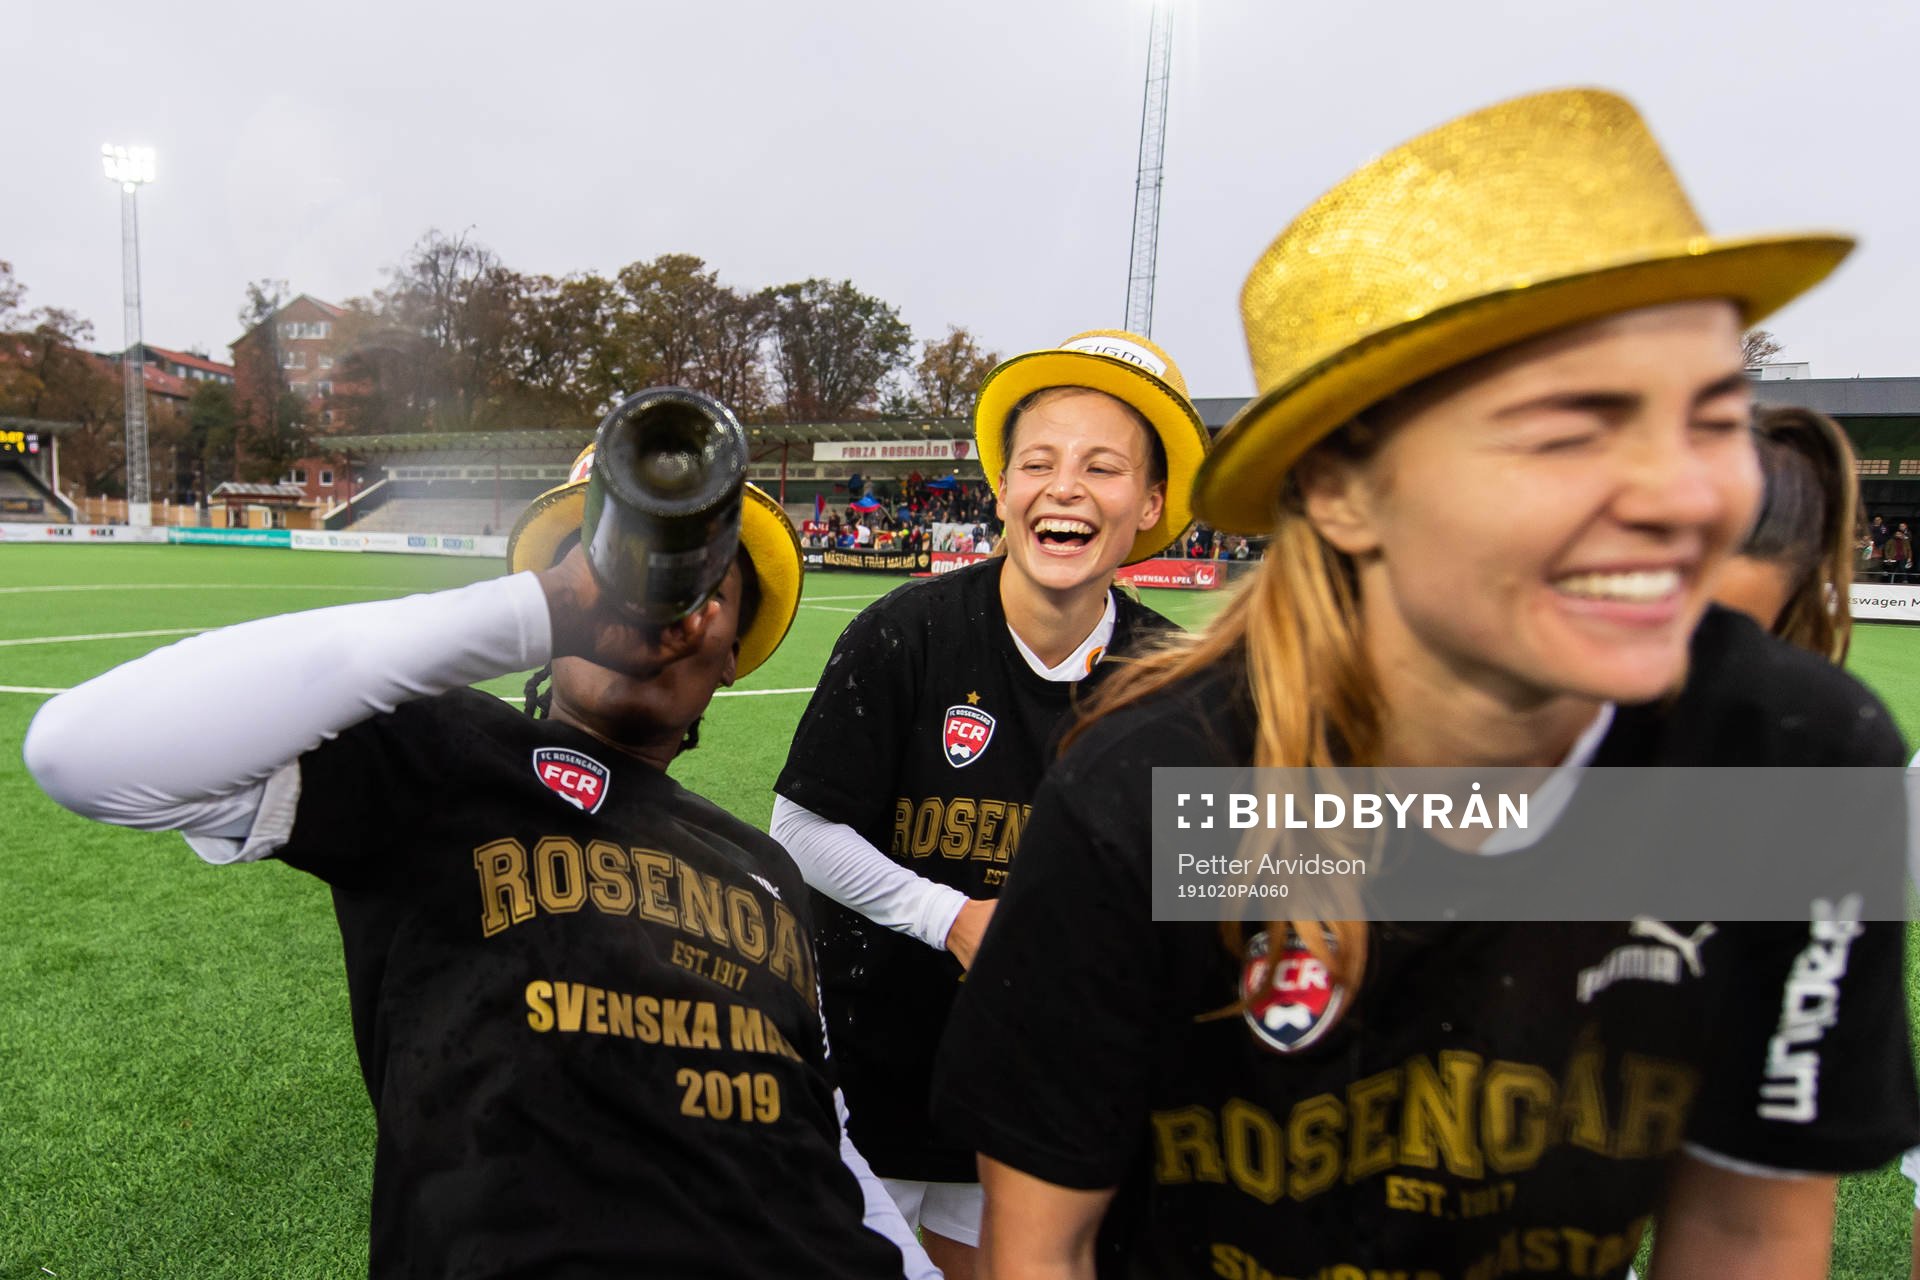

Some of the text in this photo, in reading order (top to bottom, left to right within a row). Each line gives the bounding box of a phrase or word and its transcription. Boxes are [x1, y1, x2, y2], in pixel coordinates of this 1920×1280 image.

[841, 442, 948, 459] FORZA ROSENGÅRD
[1132, 575, 1193, 585] SVENSKA SPEL
[947, 719, 986, 742] FCR
[541, 752, 552, 761] FC
[544, 764, 599, 796] FCR
[525, 980, 723, 1050] SVENSKA
[676, 1068, 781, 1124] 2019
